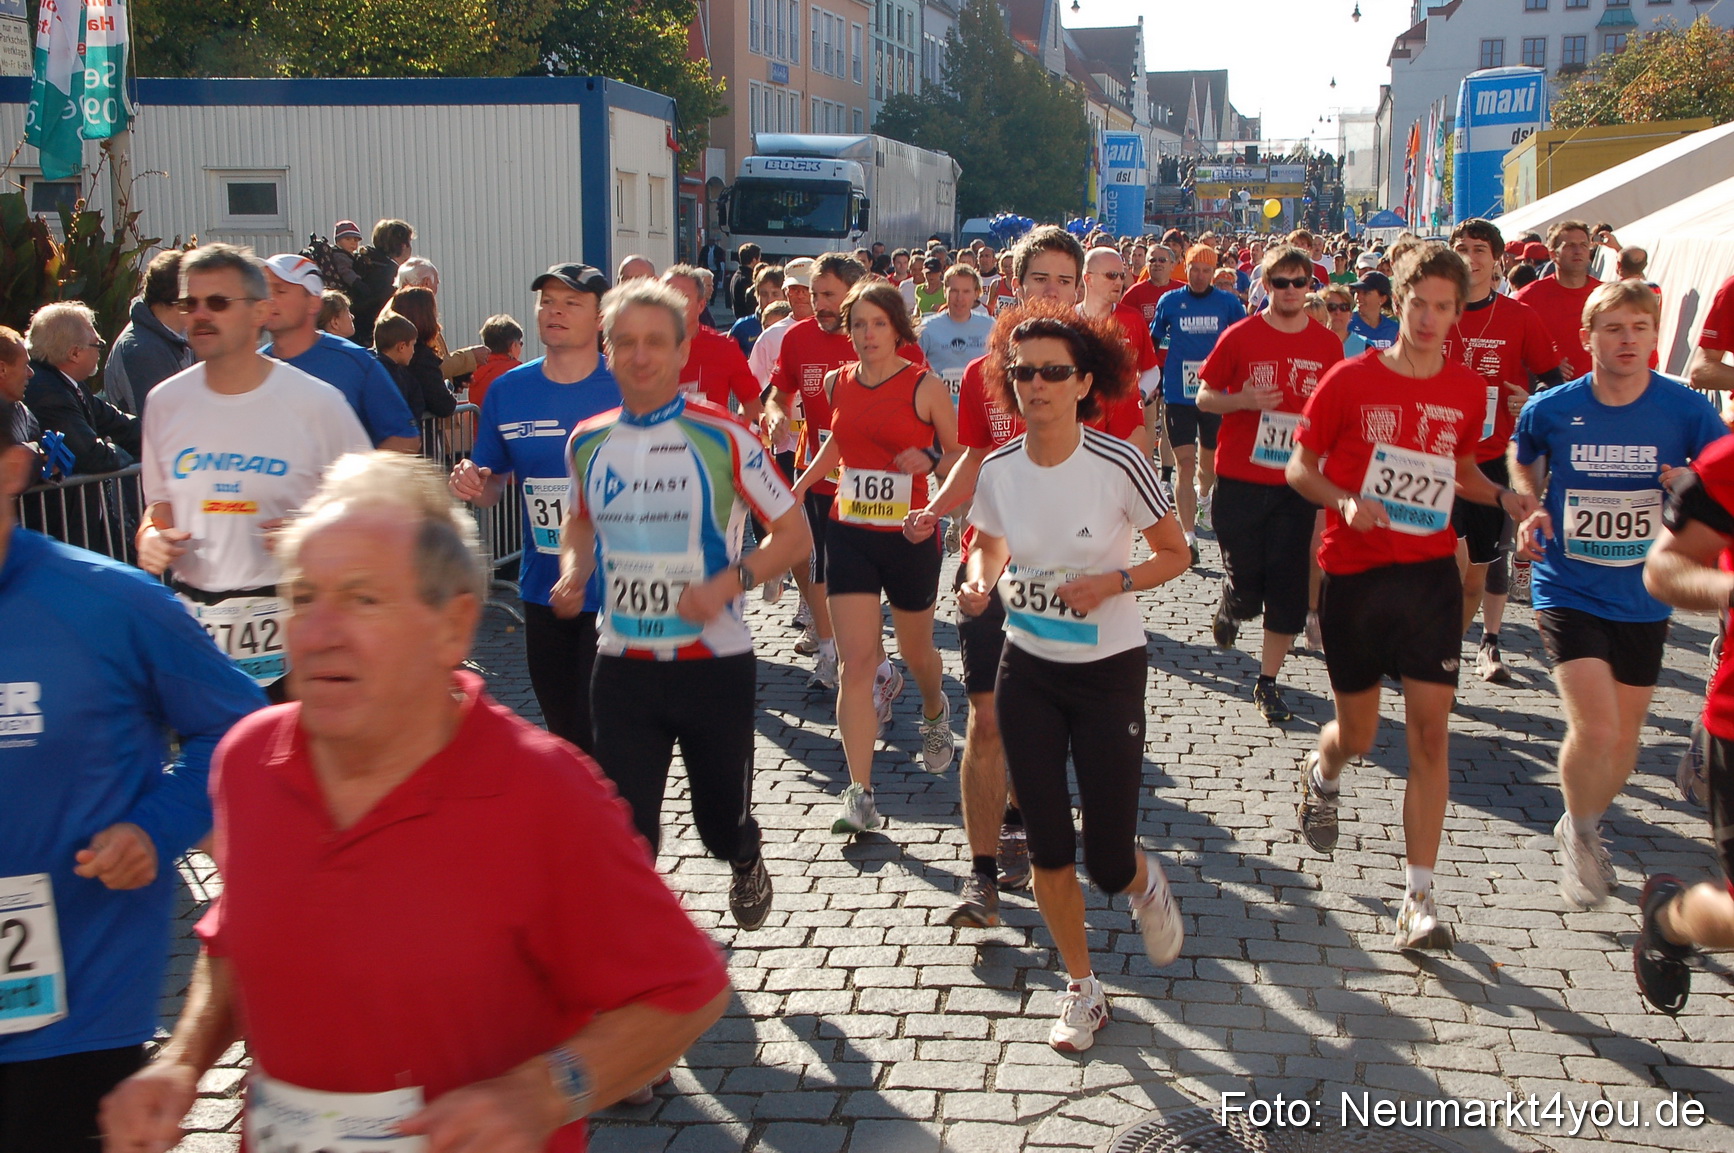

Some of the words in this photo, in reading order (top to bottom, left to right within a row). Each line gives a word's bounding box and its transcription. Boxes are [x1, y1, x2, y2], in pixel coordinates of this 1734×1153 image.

[1475, 82, 1537, 116] maxi
[1107, 142, 1134, 161] axi
[765, 160, 821, 172] BOCK
[1116, 170, 1131, 183] dsl
[803, 379, 821, 387] NEU
[992, 420, 1010, 430] NEU
[1571, 444, 1658, 463] HUBER
[174, 447, 288, 479] CONRAD
[1588, 463, 1653, 471] TECHNOLOGY
[633, 476, 690, 494] PLAST
[853, 475, 894, 501] 168
[1374, 468, 1447, 508] 3227
[852, 501, 893, 516] Martha
[1580, 496, 1621, 505] PFLEIDERER
[1576, 510, 1651, 540] 2095
[1580, 540, 1645, 557] Thomas
